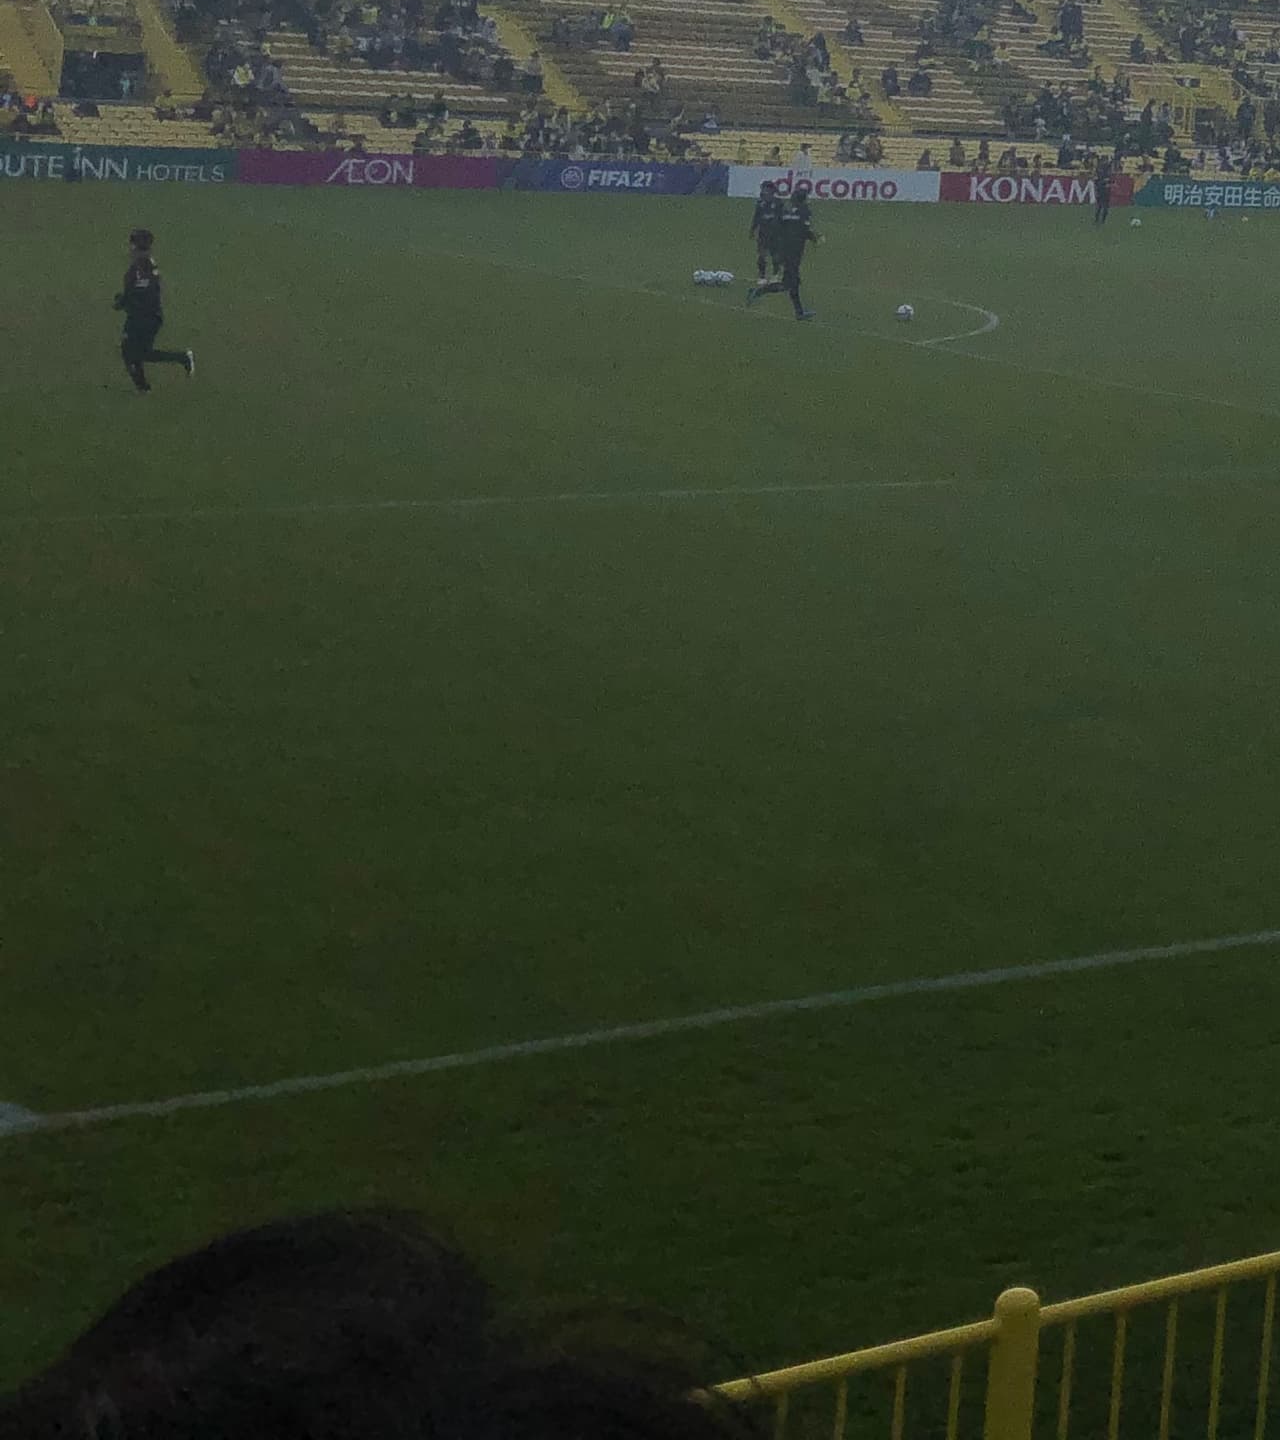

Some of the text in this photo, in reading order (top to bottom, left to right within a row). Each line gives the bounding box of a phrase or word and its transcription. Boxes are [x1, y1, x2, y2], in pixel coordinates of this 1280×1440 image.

[0, 155, 64, 179] UTE
[136, 164, 225, 182] HOTELS
[774, 169, 898, 200] docomo
[969, 175, 1097, 204] KONAM
